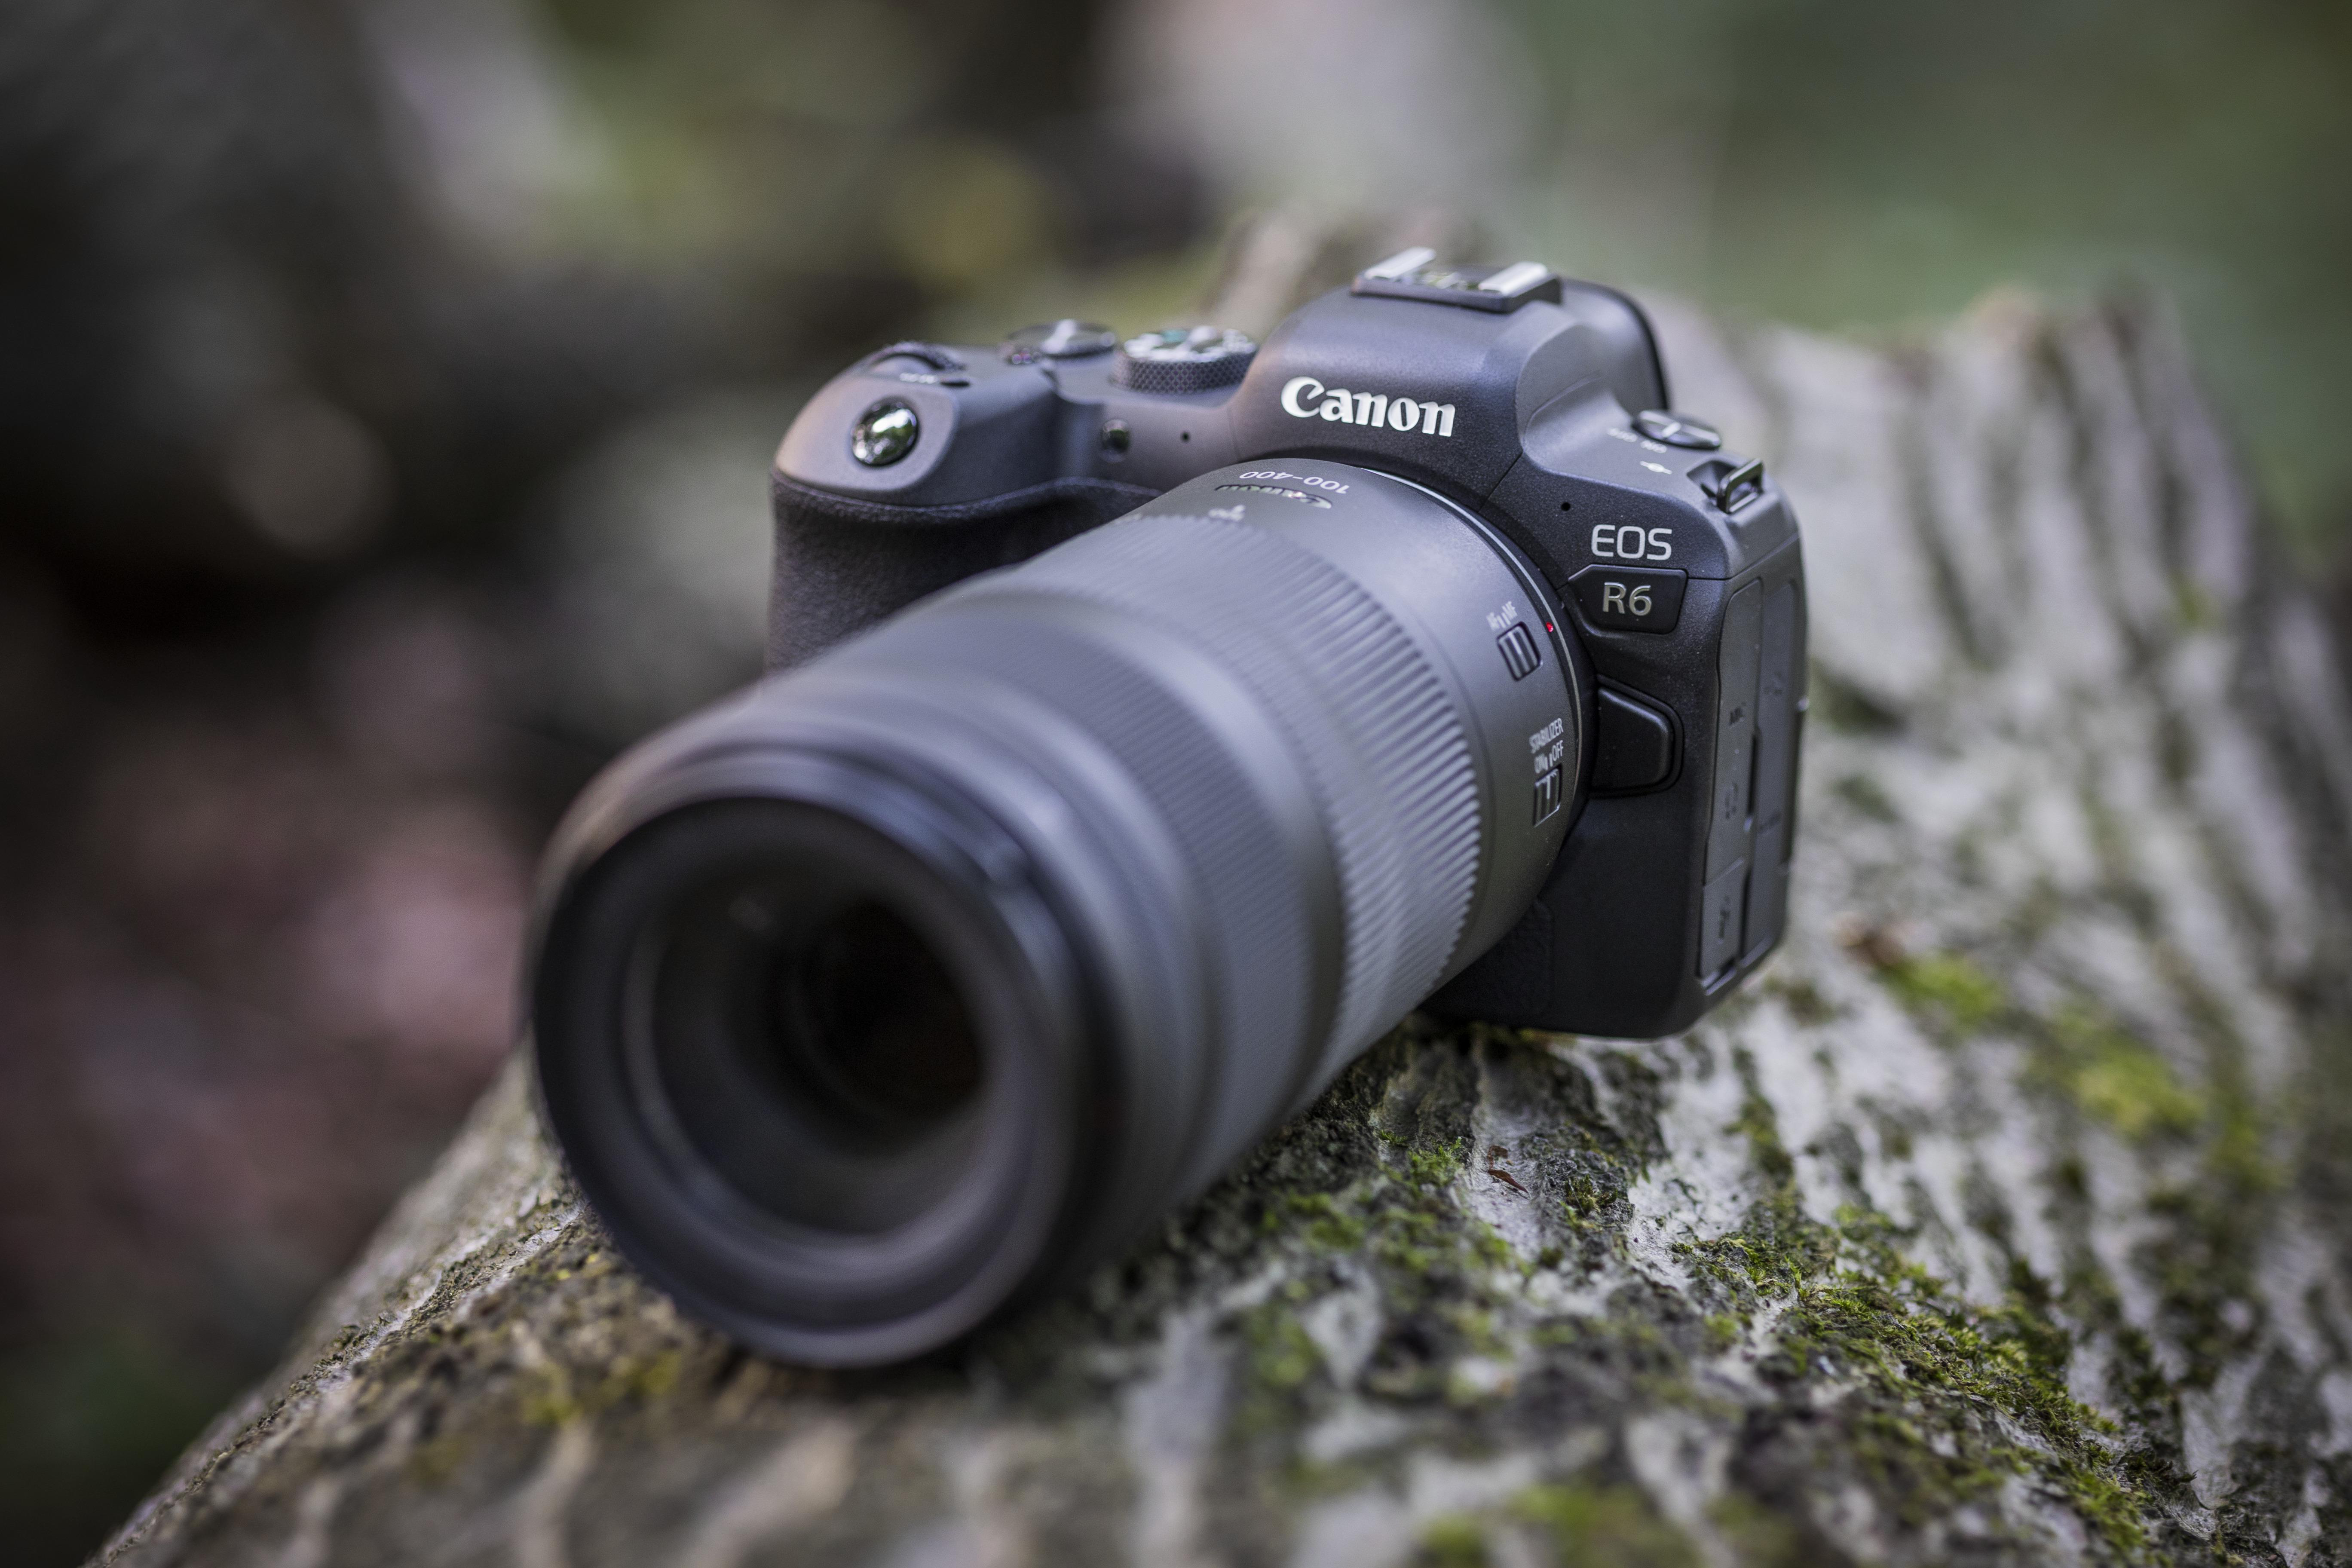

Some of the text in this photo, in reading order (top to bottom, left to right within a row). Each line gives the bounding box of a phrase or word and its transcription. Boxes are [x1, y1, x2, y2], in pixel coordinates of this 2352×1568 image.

[1280, 376, 1456, 437] Canon
[1239, 471, 1350, 494] 100-400
[1591, 524, 1672, 560] EOS
[1602, 582, 1652, 616] R6
[1529, 718, 1563, 754] STABILIZER
[1552, 740, 1563, 761] OFF
